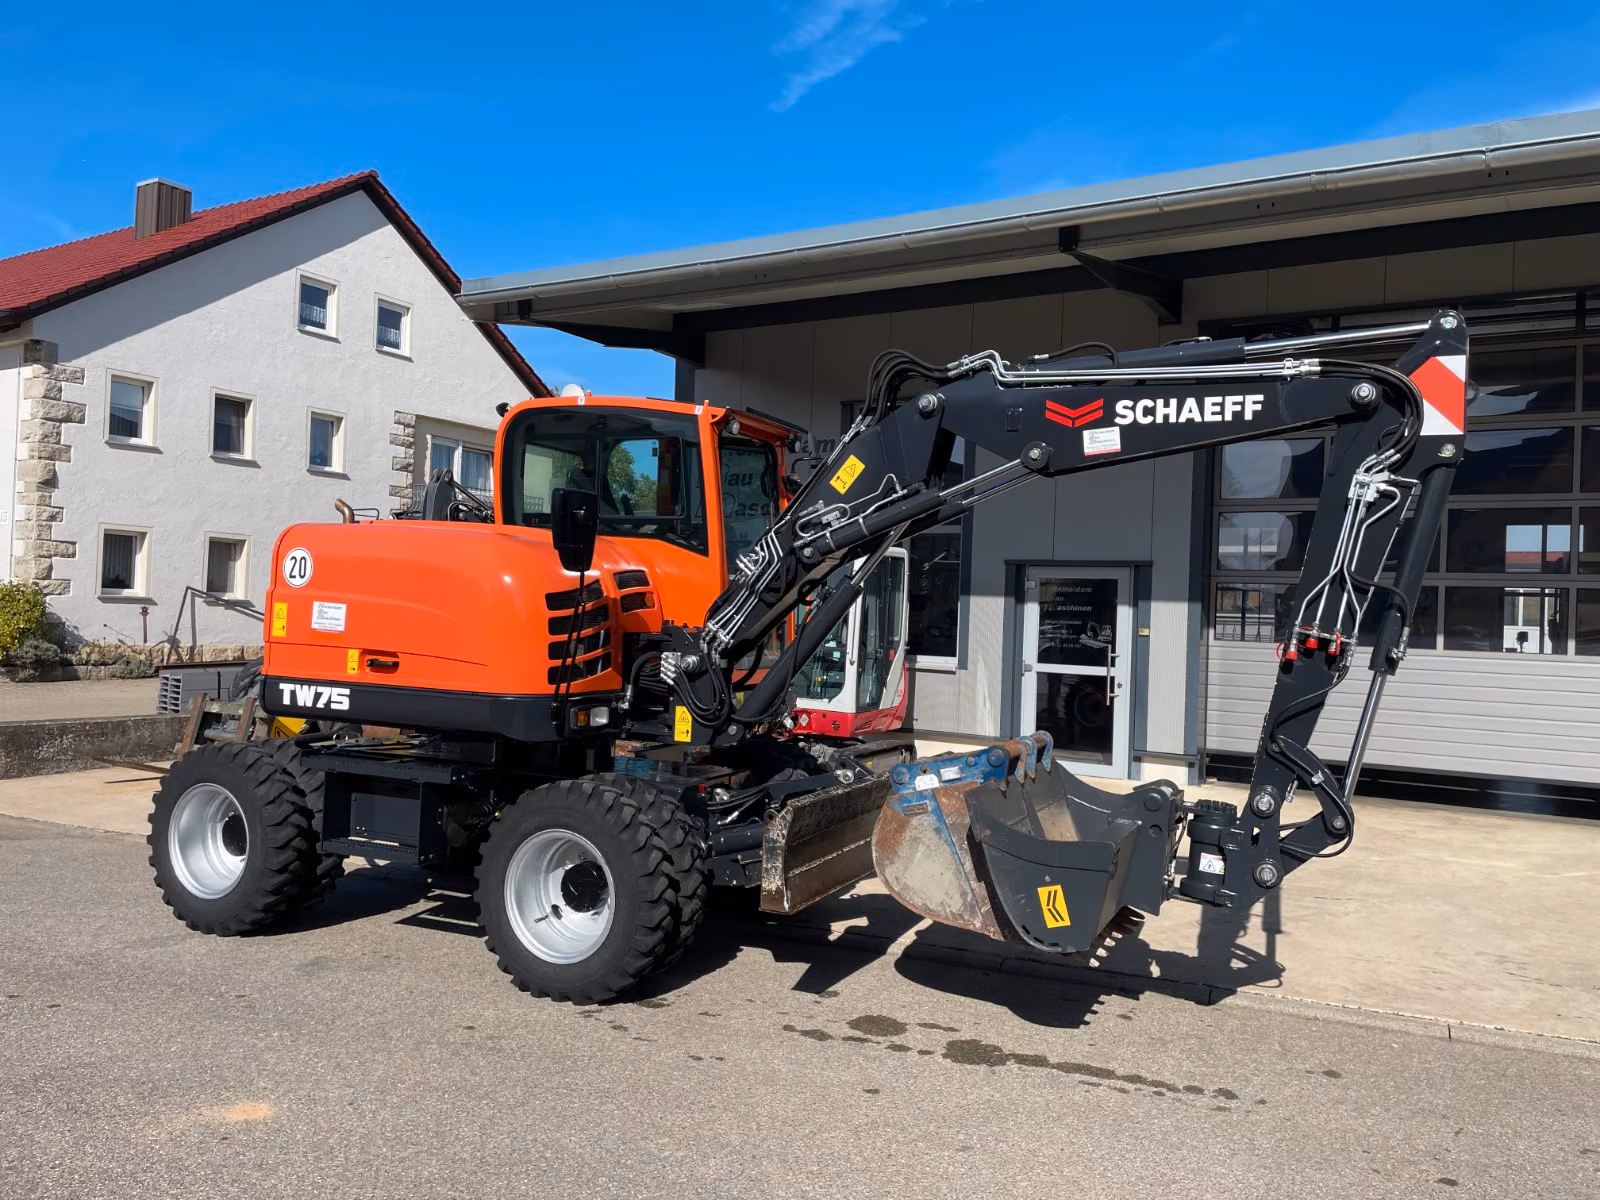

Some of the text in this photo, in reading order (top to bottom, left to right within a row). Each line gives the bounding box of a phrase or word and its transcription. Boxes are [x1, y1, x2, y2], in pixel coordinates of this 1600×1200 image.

[1114, 394, 1265, 425] SCHAEFF
[289, 556, 307, 579] 20
[279, 683, 350, 710] TW75
